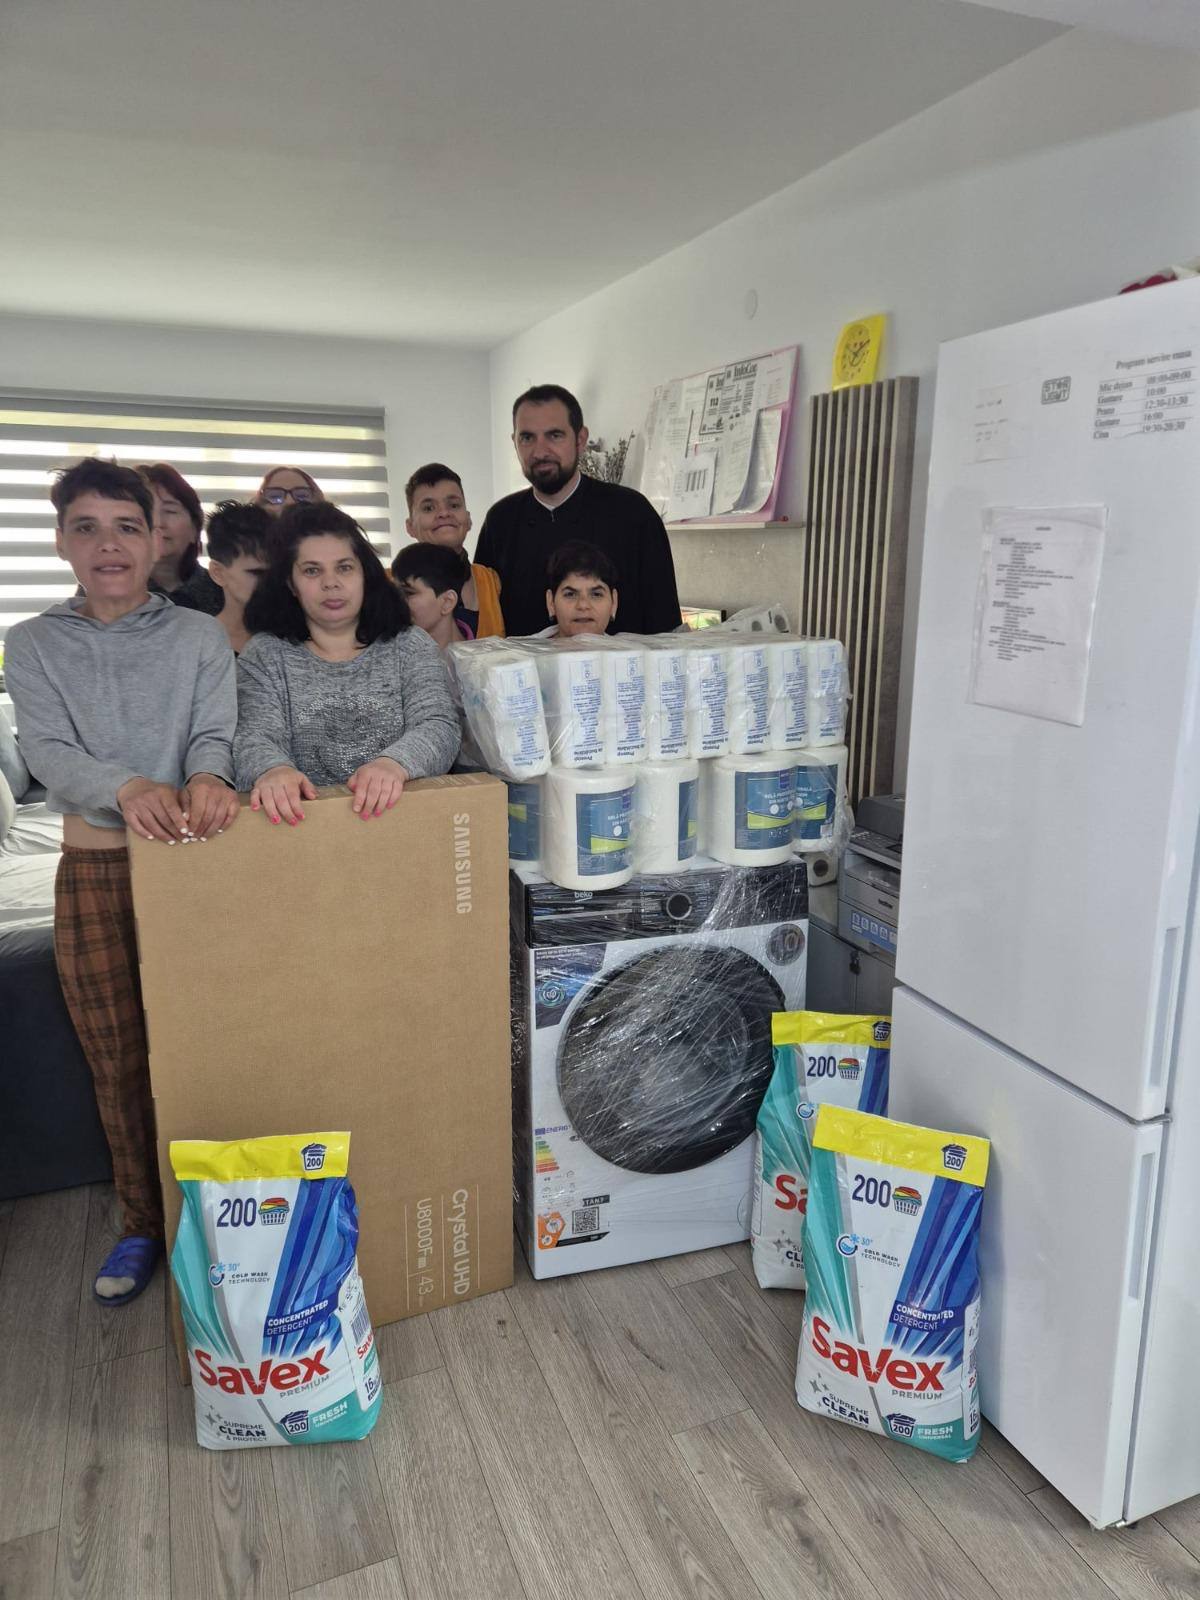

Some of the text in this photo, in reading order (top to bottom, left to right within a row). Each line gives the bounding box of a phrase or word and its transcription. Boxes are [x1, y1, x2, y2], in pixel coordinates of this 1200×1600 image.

[453, 813, 472, 915] SAMSUNG
[574, 890, 593, 900] beko
[875, 1030, 889, 1040] 200
[807, 1056, 836, 1079] 200
[307, 1156, 322, 1168] 200
[946, 1156, 962, 1168] 200
[852, 1174, 891, 1208] 200
[216, 1197, 257, 1228] 200
[416, 1197, 433, 1257] U8000F
[447, 1188, 470, 1295] Crystal UHD
[861, 1253, 900, 1267] TECHNOLOGY
[228, 1277, 271, 1285] TECHNOLOGY
[419, 1276, 434, 1295] 43
[268, 1300, 329, 1328] CONCENTRATED
[896, 1303, 954, 1320] CONCENTRATED
[266, 1316, 313, 1336] DETERGENT
[893, 1314, 939, 1330] DETERGENT
[280, 1374, 330, 1399] PREMIUM
[891, 1389, 943, 1401] PREMIUM
[313, 1401, 348, 1425] FRESH
[821, 1396, 870, 1425] CLEAN
[829, 1393, 870, 1417] SUPREME
[219, 1425, 266, 1437] CLEAN
[223, 1420, 264, 1430] SUPREME
[288, 1421, 307, 1433] 200
[893, 1423, 910, 1436] 200
[917, 1425, 953, 1436] FRESH
